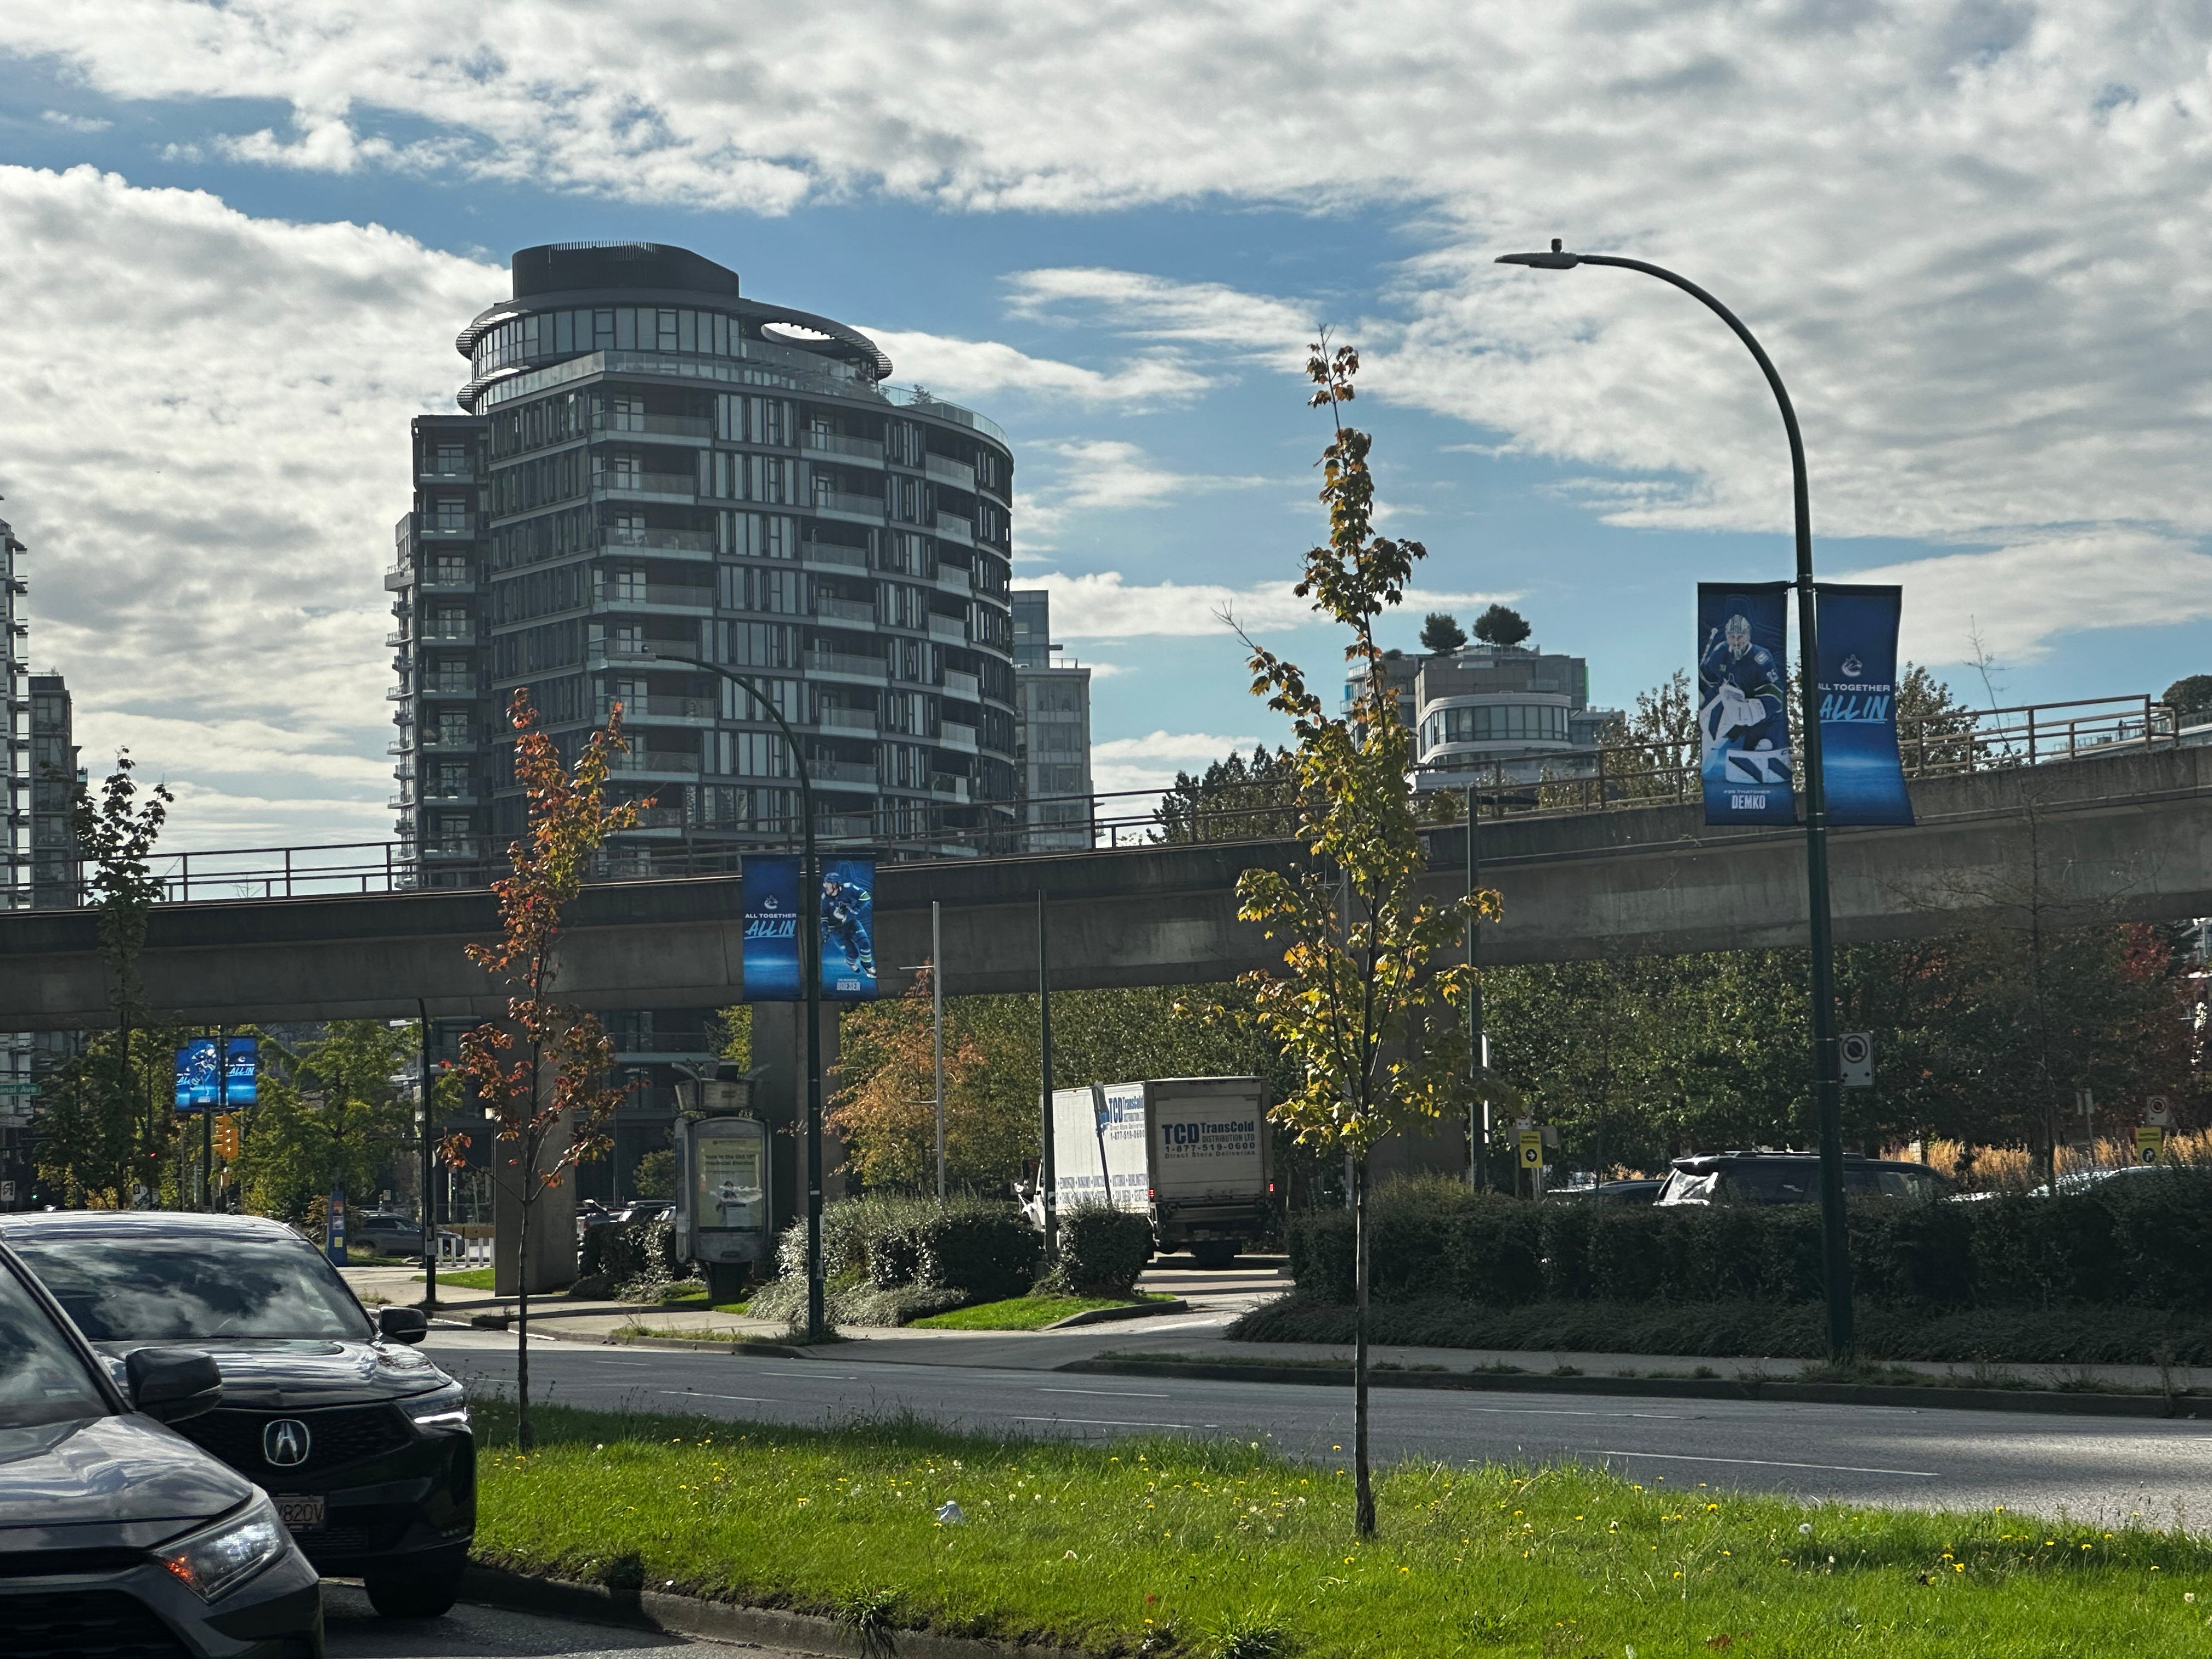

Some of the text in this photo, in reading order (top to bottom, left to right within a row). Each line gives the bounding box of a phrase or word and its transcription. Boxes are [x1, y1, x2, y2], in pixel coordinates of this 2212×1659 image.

[1833, 684, 1891, 692] TOGETHER
[1820, 693, 1890, 720] ALL IN
[1731, 795, 1766, 809] DEMKO
[745, 919, 796, 936] ALL IN
[837, 981, 861, 991] BOESER
[20, 1085, 37, 1093] Ave
[1108, 1097, 1123, 1124] TCD
[1162, 1121, 1254, 1145] TCD TransCold
[1202, 1133, 1255, 1143] DISTRIBUTION LTD
[1165, 1142, 1255, 1153] 1-877-519-0600
